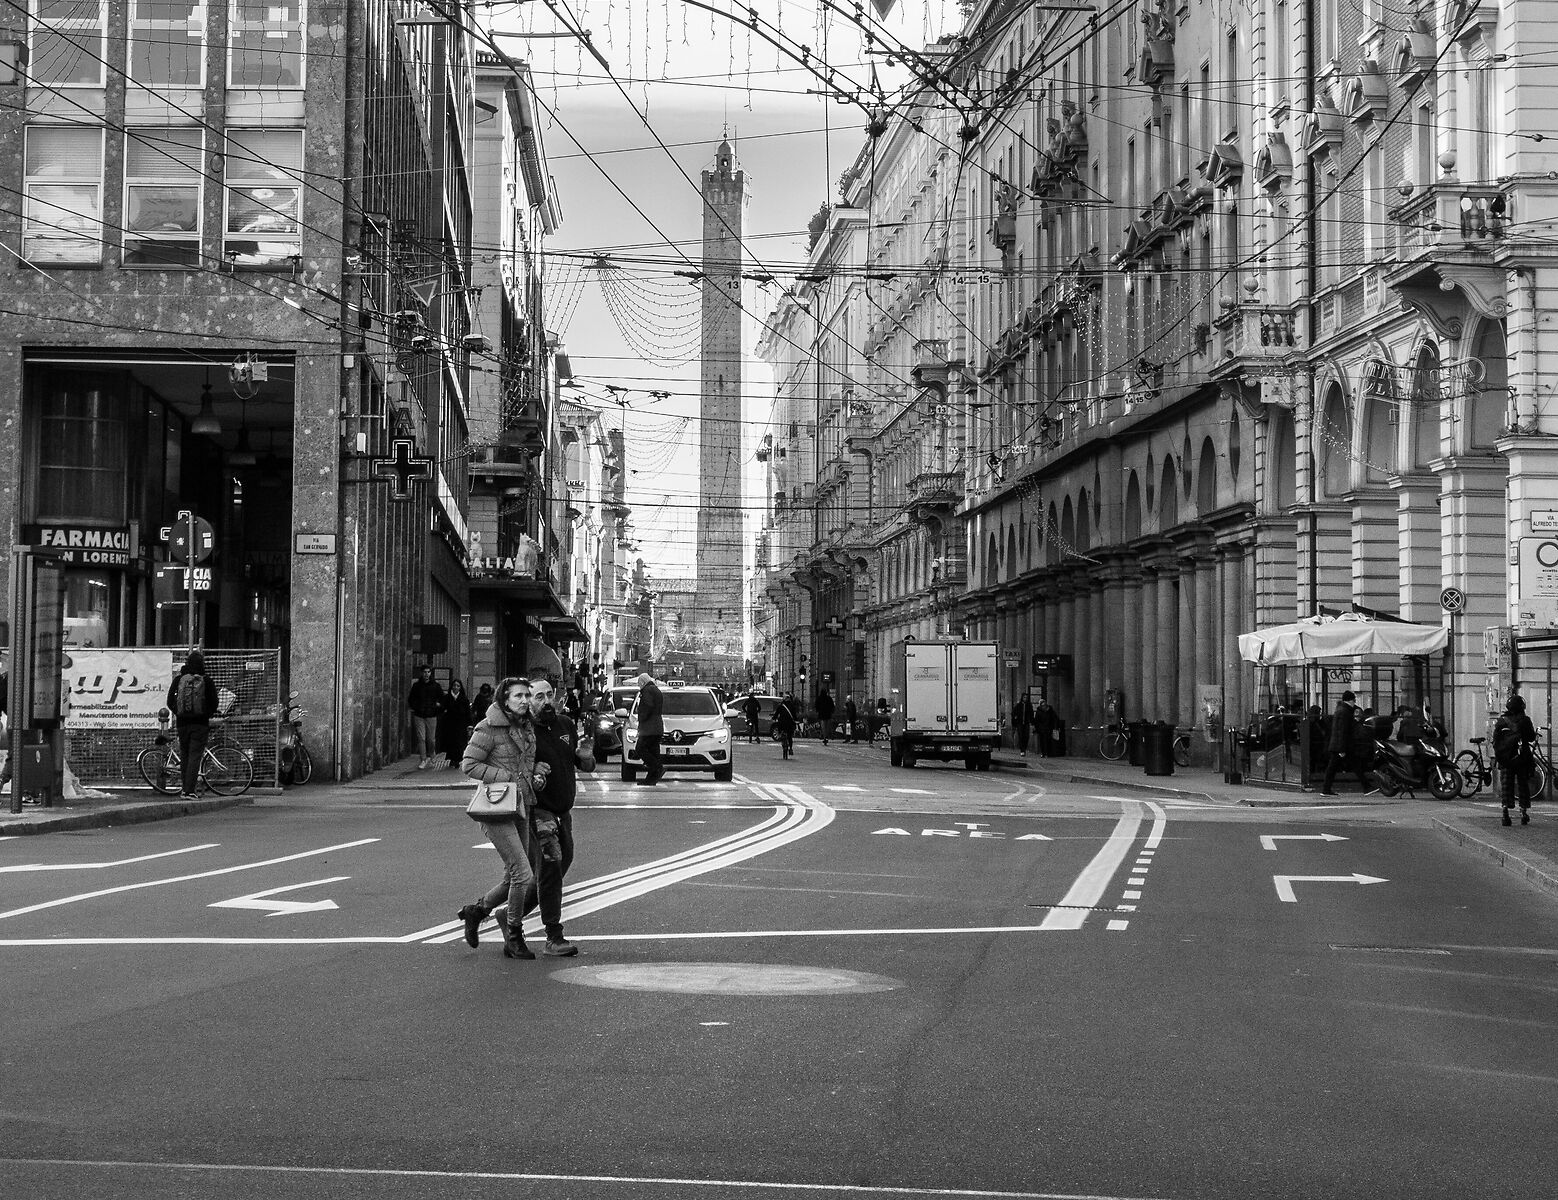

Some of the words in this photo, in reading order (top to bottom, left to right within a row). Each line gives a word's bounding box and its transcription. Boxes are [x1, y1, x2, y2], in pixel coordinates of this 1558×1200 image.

[726, 280, 739, 289] 13
[951, 276, 964, 285] 14
[977, 275, 990, 284] 15
[41, 529, 130, 549] FARMACIA
[83, 552, 129, 566] LORENZO
[1005, 650, 1020, 658] TAXI
[144, 683, 165, 693] S.r.l.
[870, 827, 1055, 841] AREA
